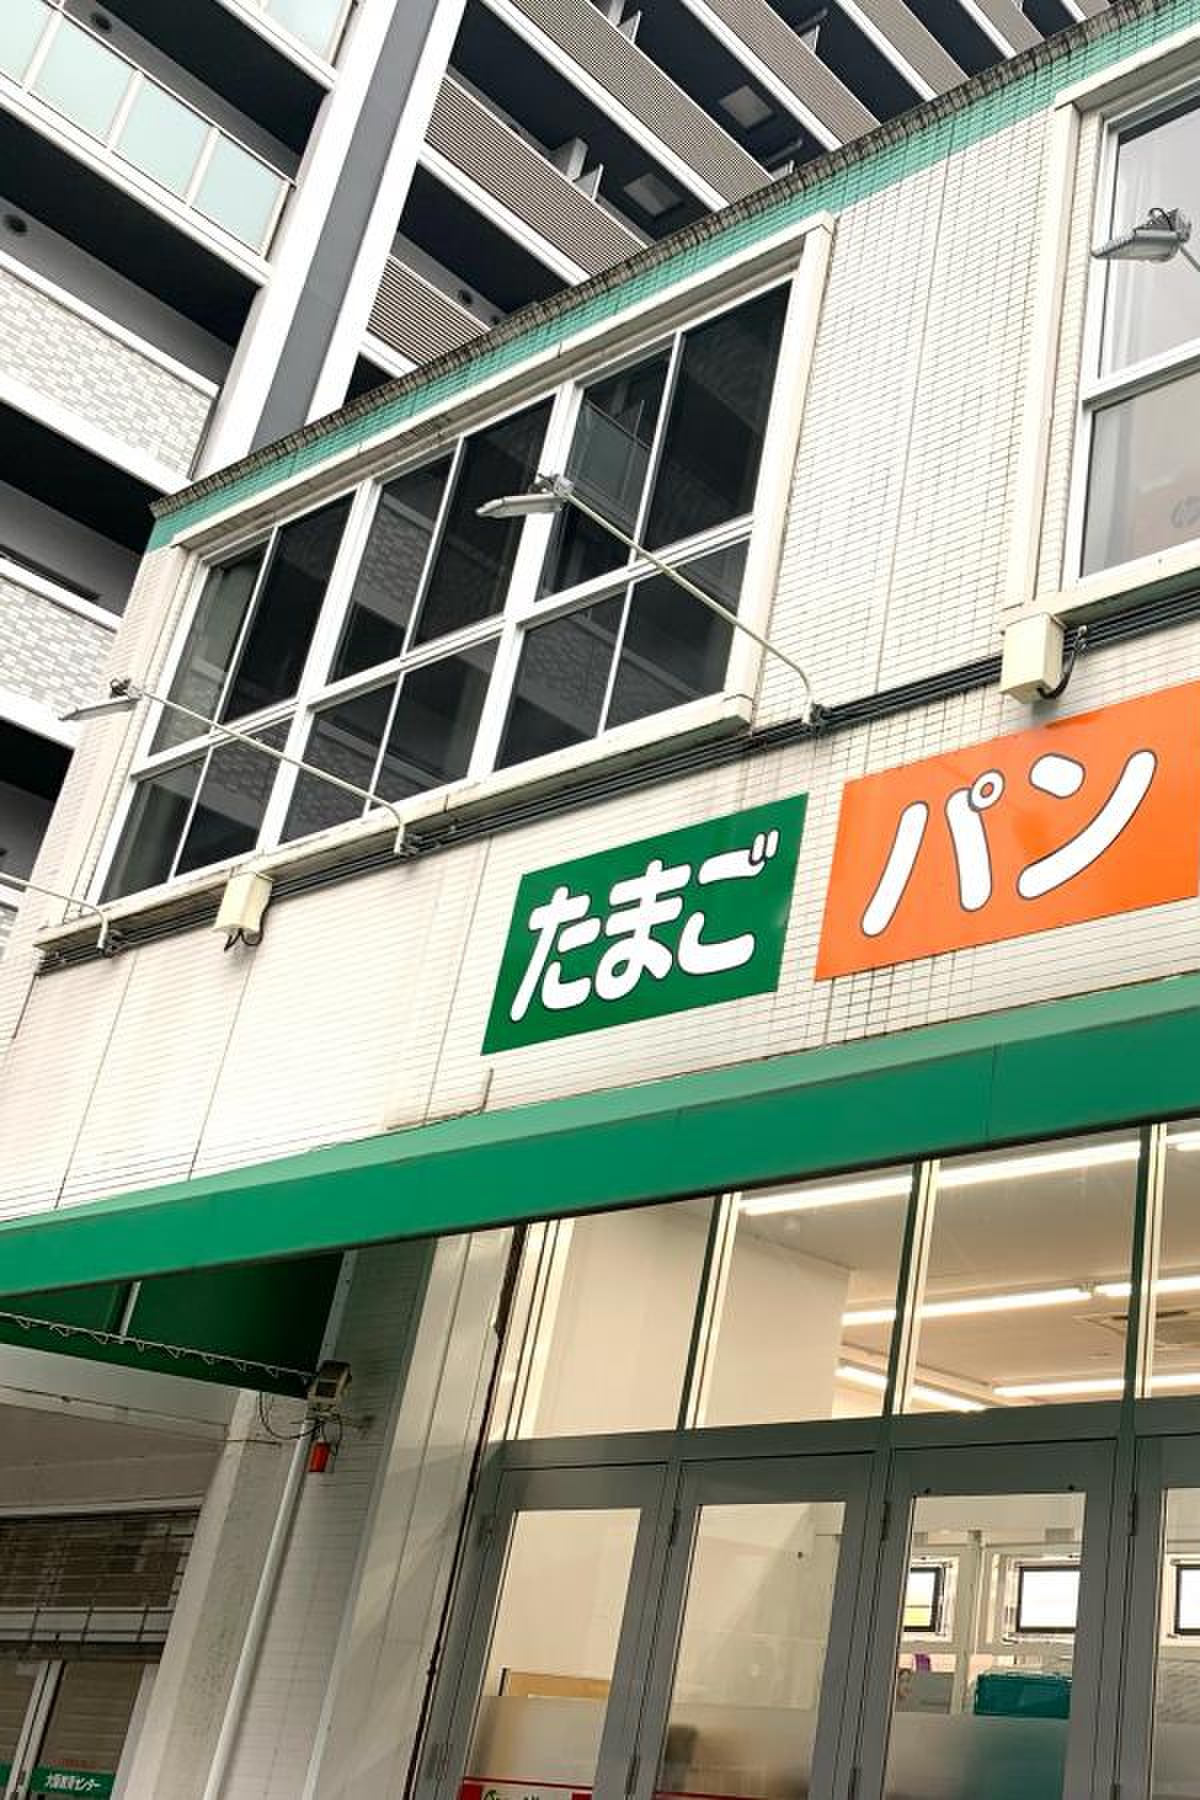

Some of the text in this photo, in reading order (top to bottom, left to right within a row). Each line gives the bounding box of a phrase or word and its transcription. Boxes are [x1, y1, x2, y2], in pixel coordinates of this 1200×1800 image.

[509, 829, 779, 1022] たまご
[860, 749, 1158, 937] パン
